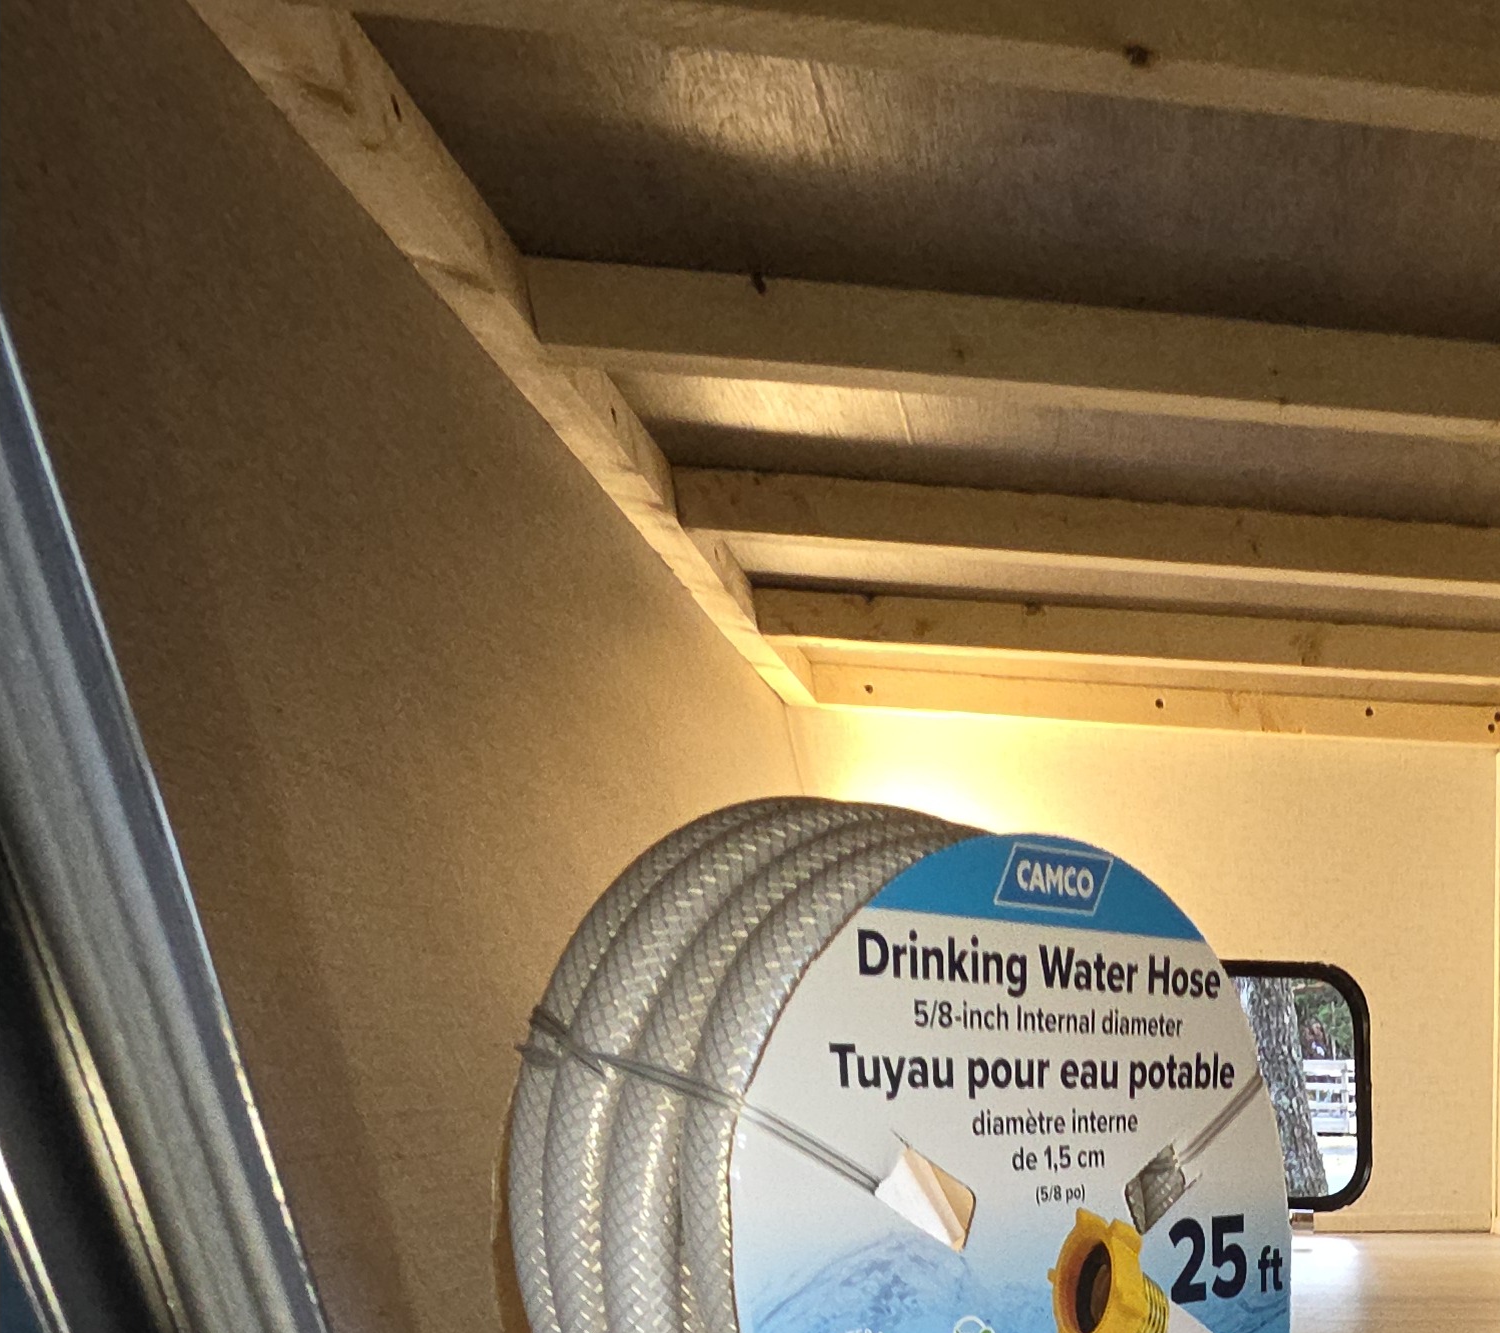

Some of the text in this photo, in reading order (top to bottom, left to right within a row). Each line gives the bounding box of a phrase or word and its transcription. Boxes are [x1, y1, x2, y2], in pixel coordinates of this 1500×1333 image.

[1017, 859, 1094, 899] CAMCO
[857, 928, 1221, 1000] Drinking Water Hose
[914, 998, 1183, 1038] 5/8-inch Internal diameter
[829, 1042, 1235, 1100] Tuyau pour eau potable
[972, 1108, 1138, 1136] diamètre interne
[1012, 1145, 1105, 1173] de 1,5 cm
[1035, 1184, 1086, 1206] (5/8 po)
[1169, 1213, 1283, 1305] 25 ft
